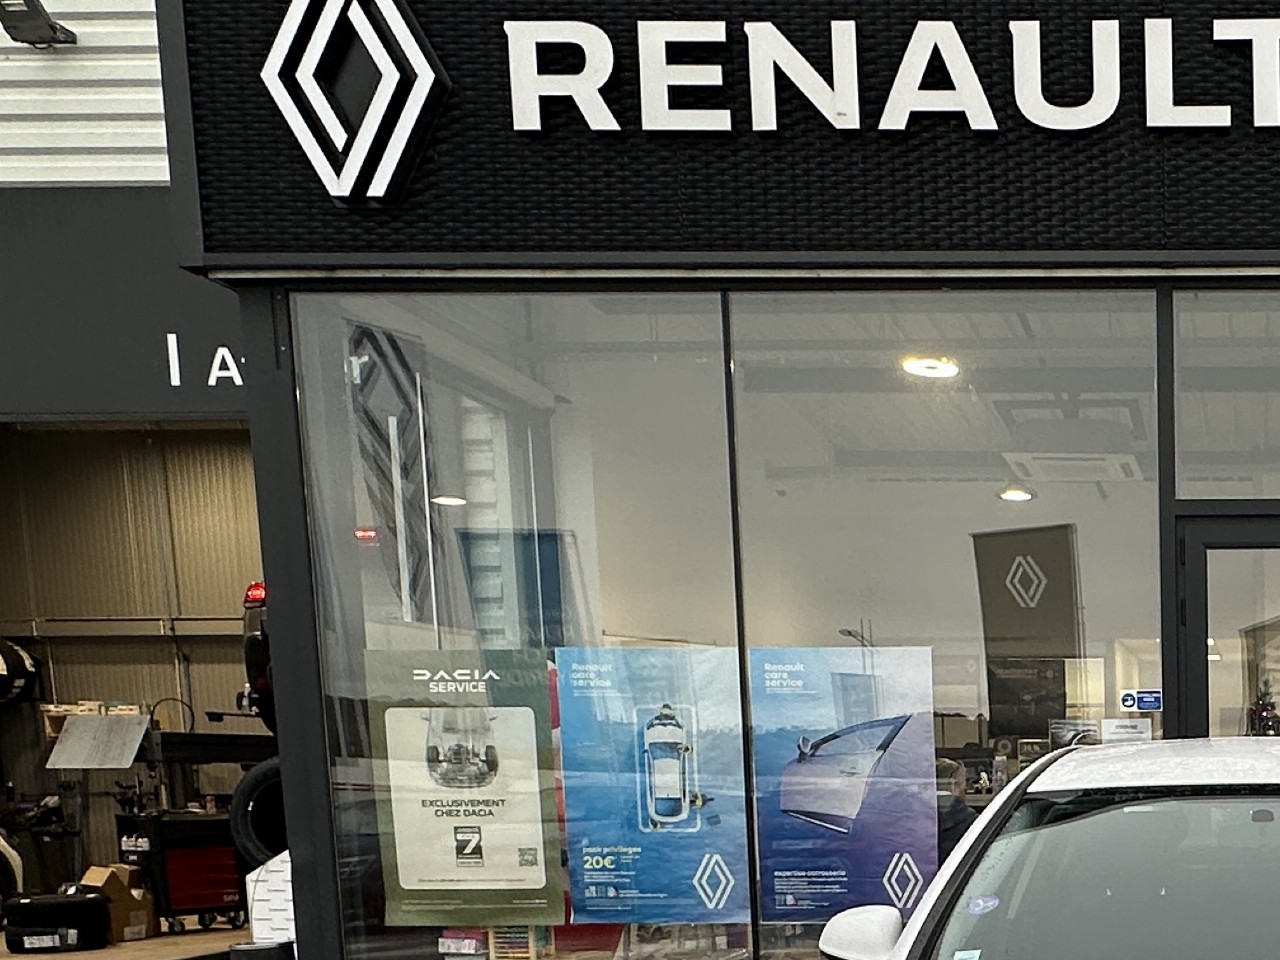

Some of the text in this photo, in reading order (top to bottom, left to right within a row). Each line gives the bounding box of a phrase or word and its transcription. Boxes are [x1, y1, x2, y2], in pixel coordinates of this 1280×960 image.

[764, 662, 805, 671] Renault
[413, 669, 500, 680] DACIA
[429, 682, 486, 692] SERVICE
[421, 799, 506, 808] EXCLUSIVEMENT
[434, 809, 494, 817] CHEZ DACIA
[583, 855, 616, 869] 20€
